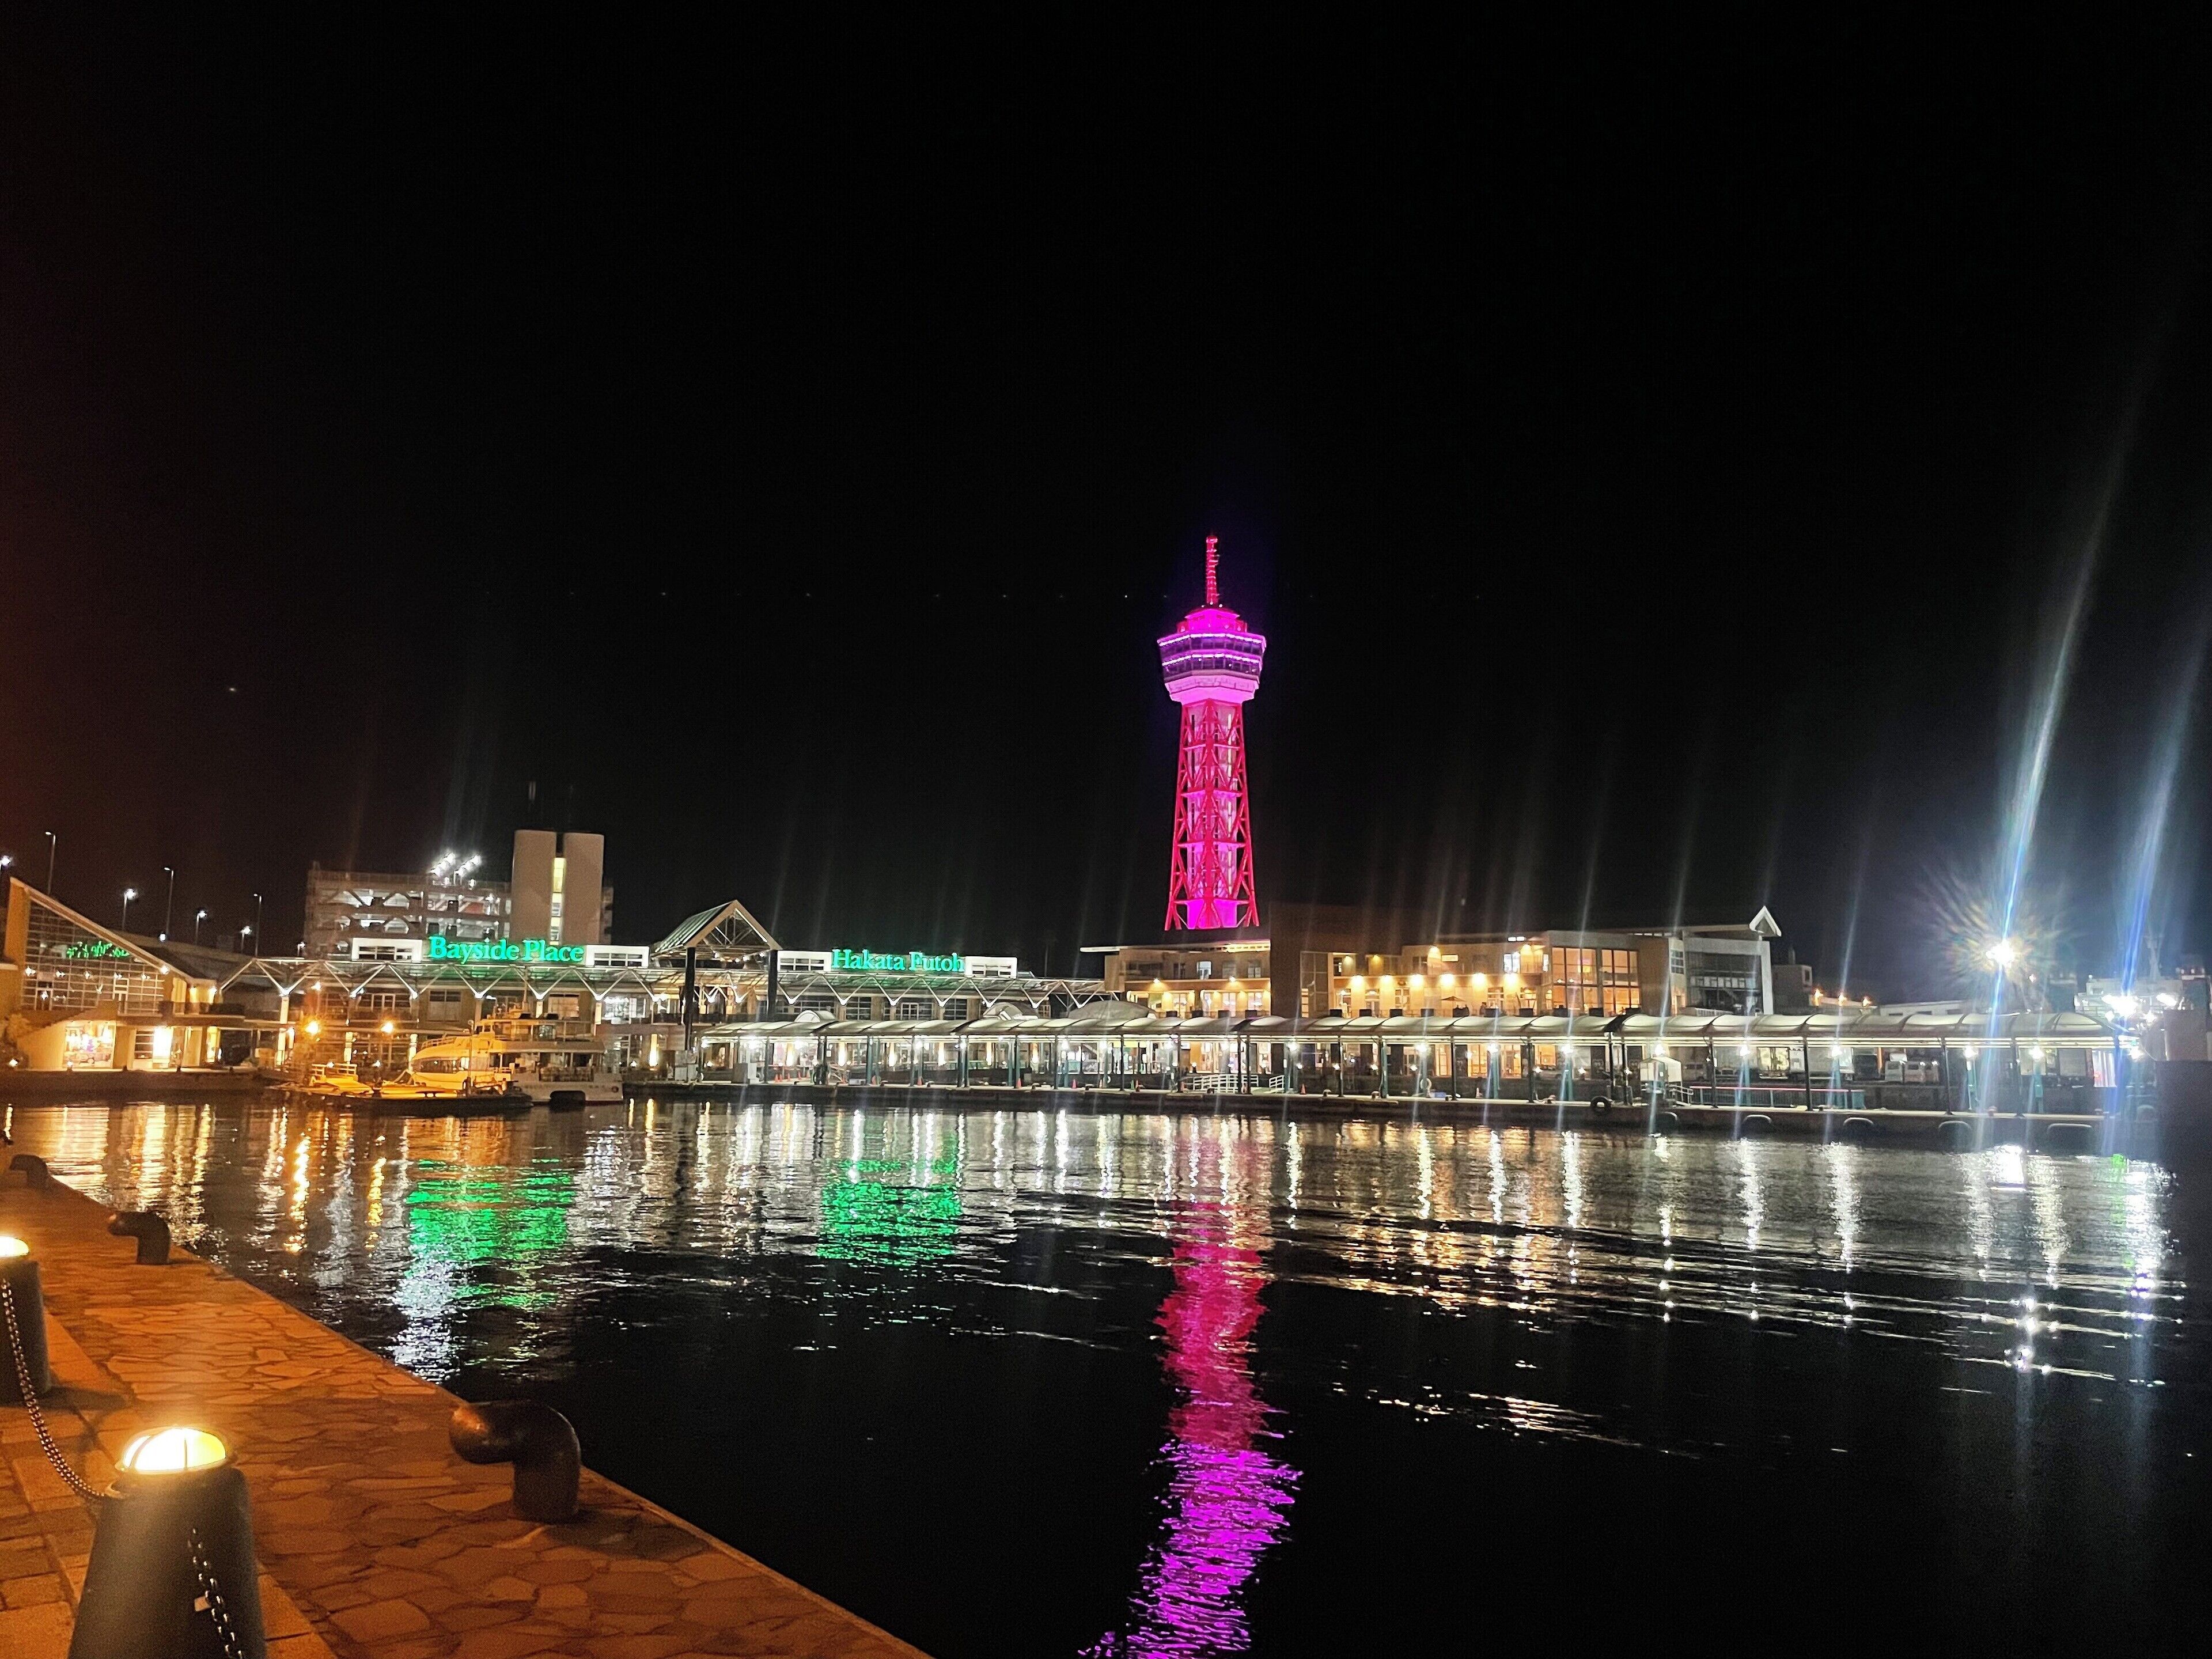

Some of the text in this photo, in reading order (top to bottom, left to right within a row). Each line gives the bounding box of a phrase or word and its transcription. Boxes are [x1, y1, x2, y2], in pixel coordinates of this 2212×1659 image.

[429, 936, 584, 964] Bayside Place
[832, 949, 965, 972] Hakata Futoh
